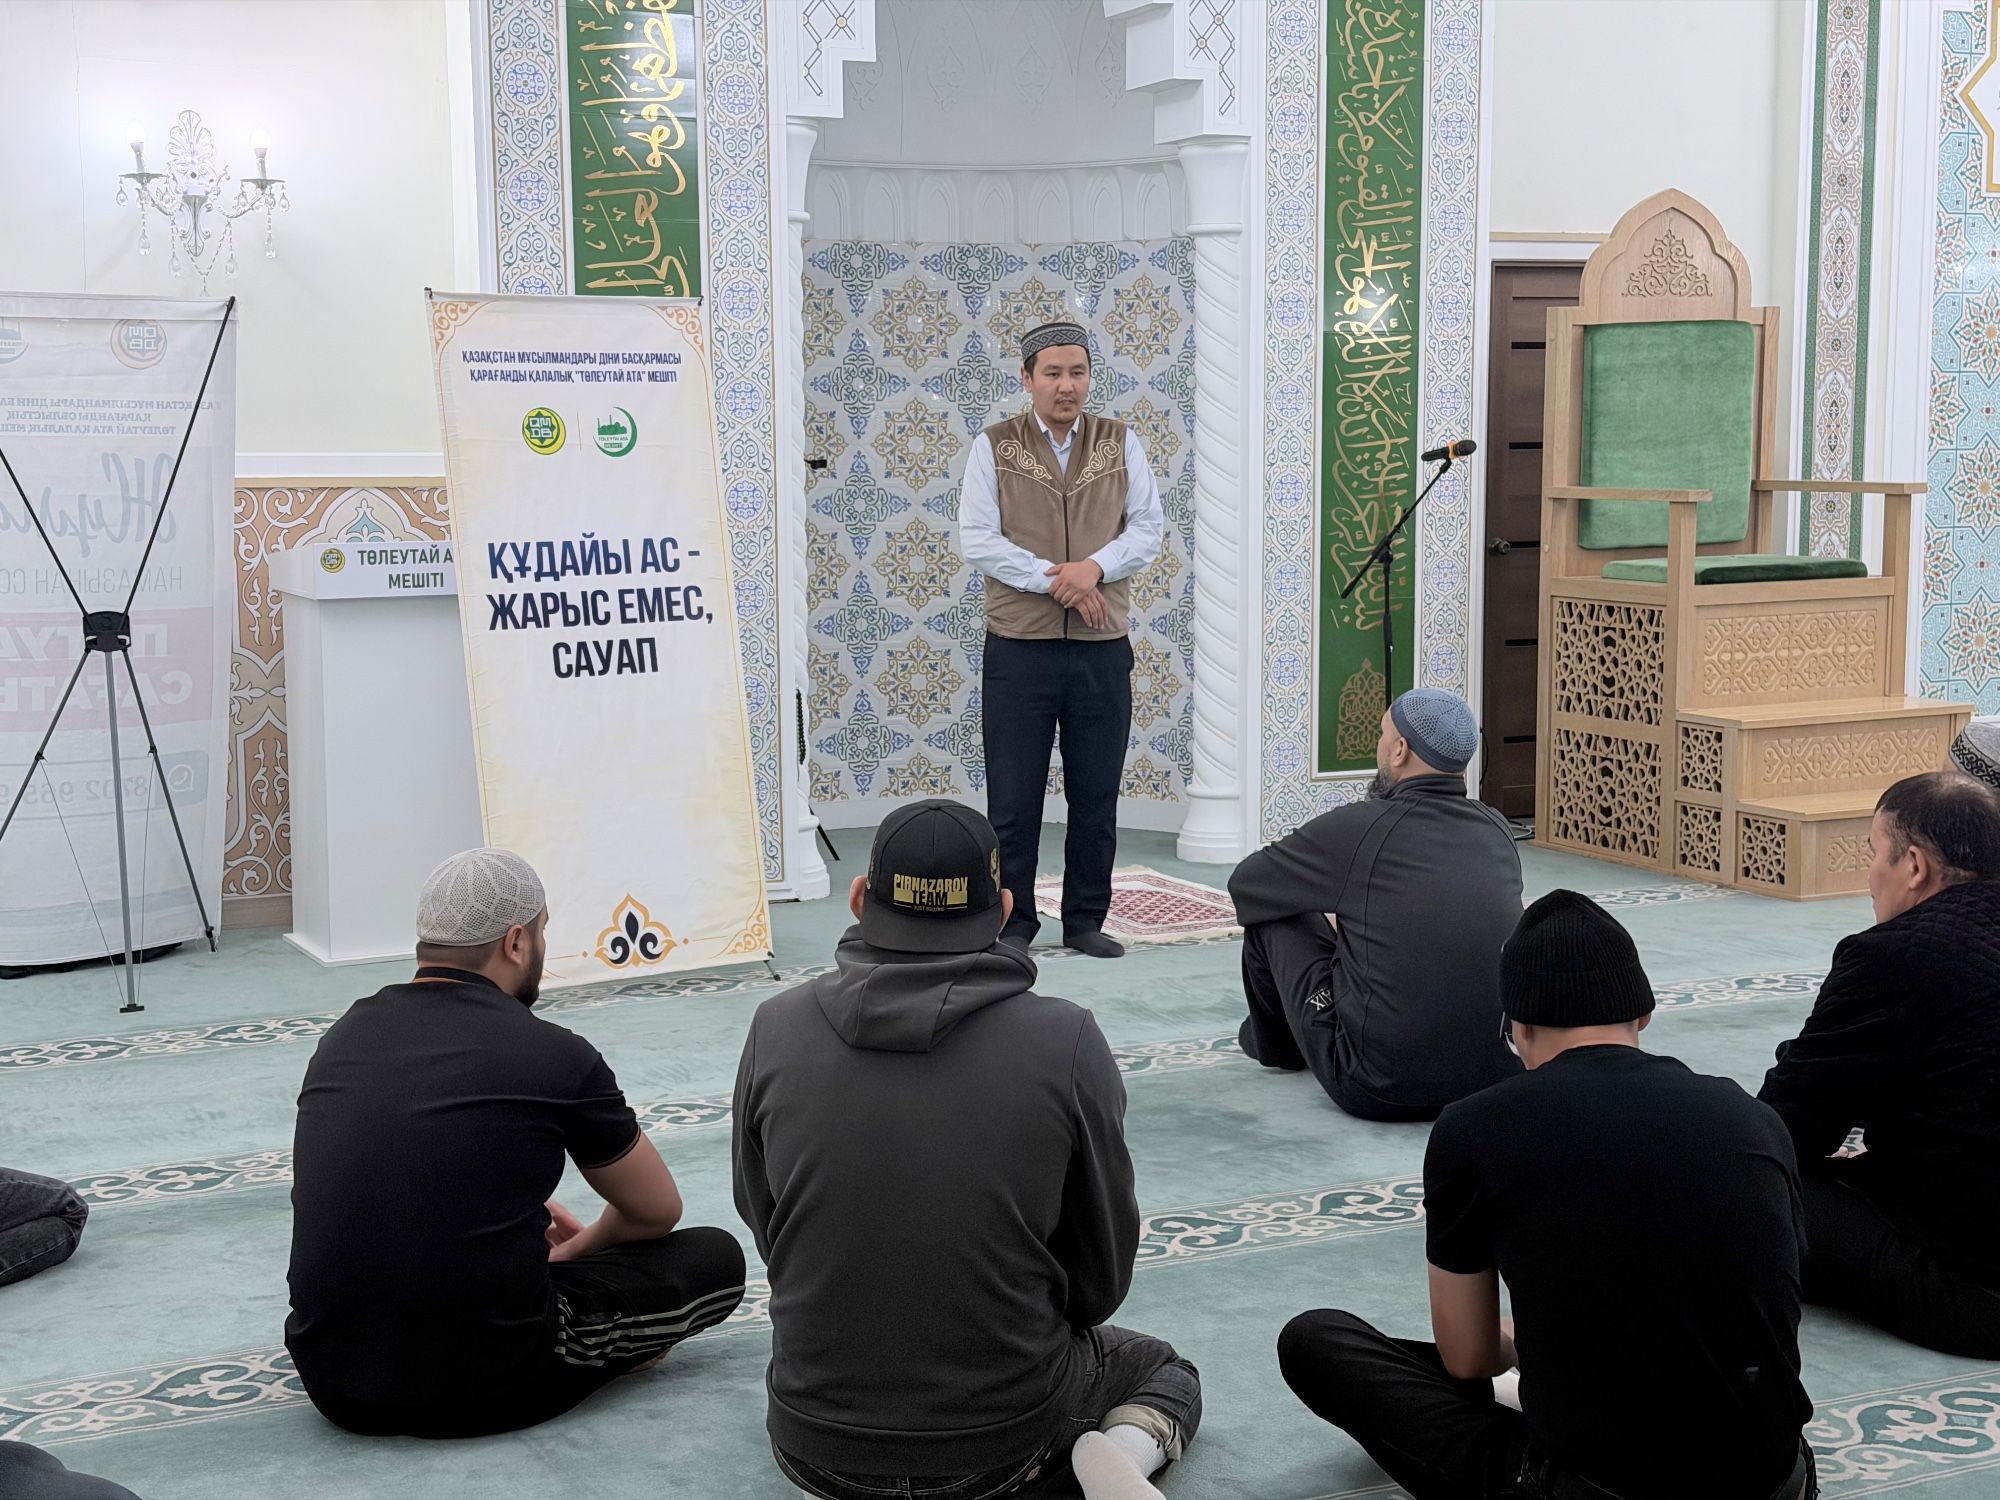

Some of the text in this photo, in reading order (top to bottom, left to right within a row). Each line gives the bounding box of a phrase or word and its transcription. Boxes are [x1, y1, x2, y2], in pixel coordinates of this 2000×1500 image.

[462, 350, 682, 366] ҚАЗАҚСТАН МҰСЫЛМАНДАРЫ ДІНИ БАСҚАРМАСЫ
[470, 369, 677, 384] ҚАРАҒАНДЫ ҚАЛАЛЫҚ "ТӨЛЕУТАЙ АТА" МЕШІТІ
[357, 544, 439, 566] ТӨЛЕУТАЙ
[443, 548, 454, 563] А
[488, 532, 632, 583] ҚҰДАЙЫ
[640, 537, 680, 574] АС
[388, 572, 444, 589] МЕШІТІ
[486, 585, 713, 631] ЖАРЫС ЕМЕС,
[553, 637, 659, 679] САУАП
[893, 873, 969, 893] PIRNAZAROV
[912, 890, 948, 906] TEAM
